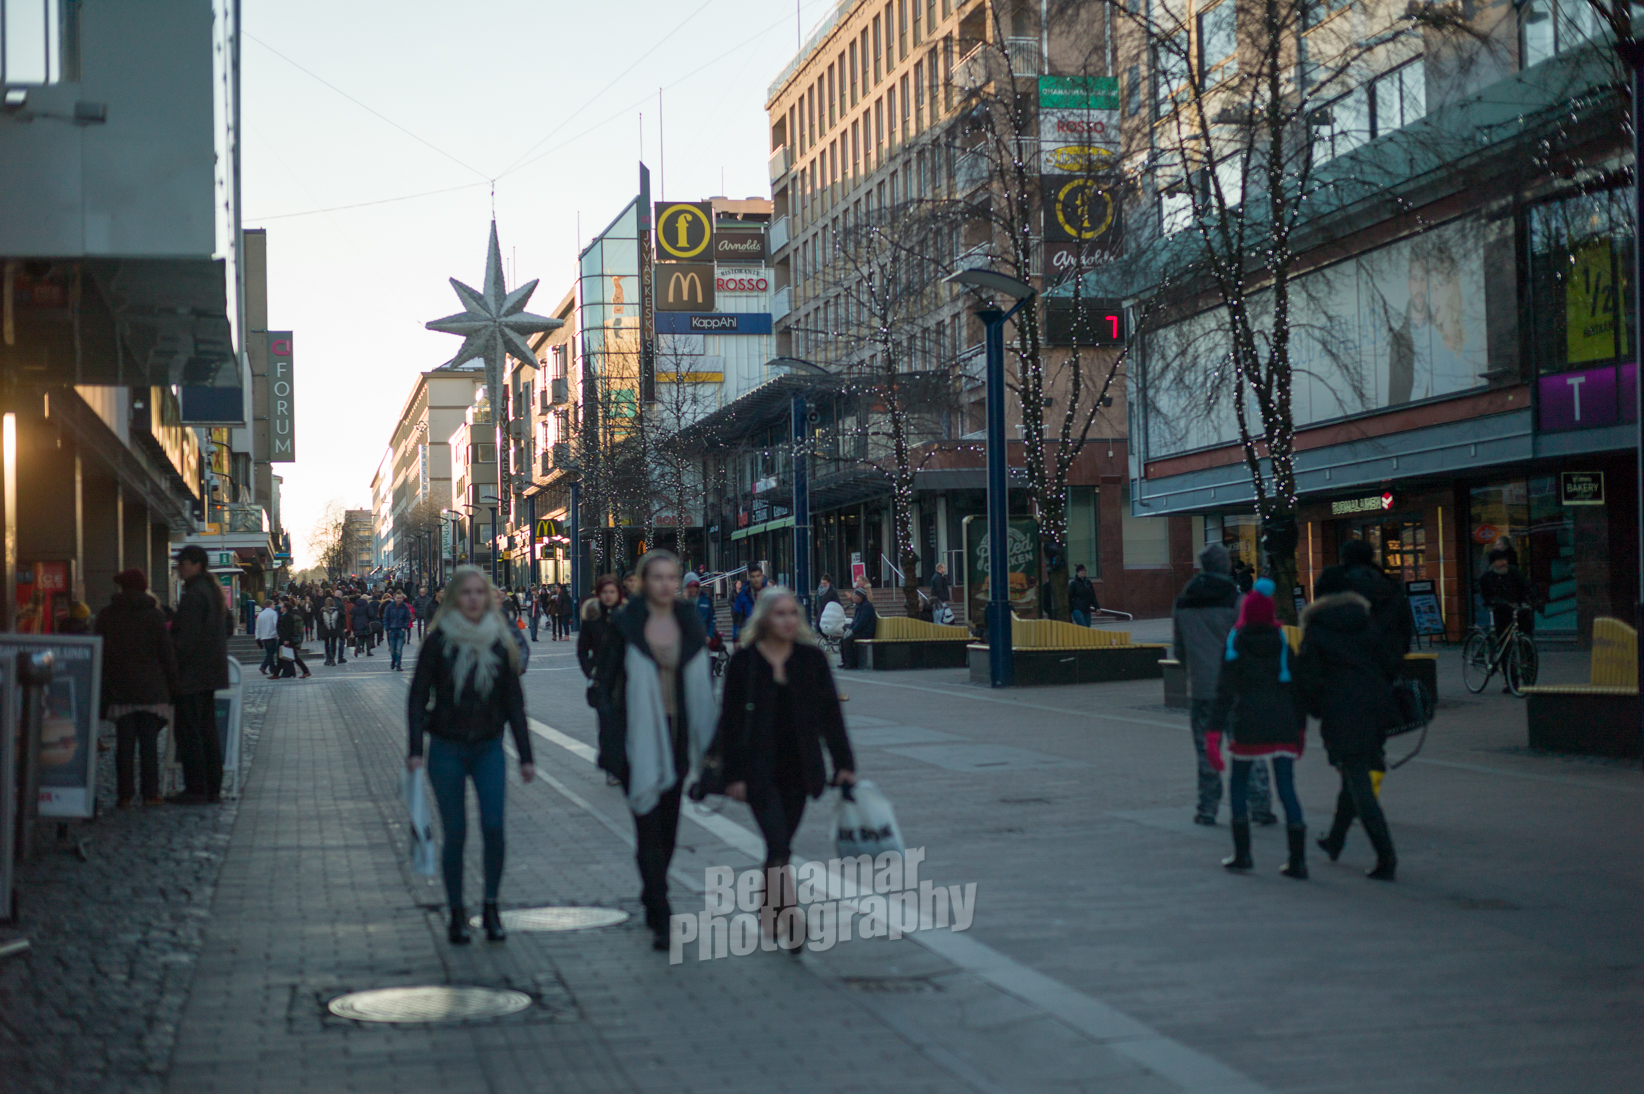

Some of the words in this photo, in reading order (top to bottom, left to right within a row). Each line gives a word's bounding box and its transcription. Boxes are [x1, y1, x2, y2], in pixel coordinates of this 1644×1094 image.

[1057, 120, 1105, 133] ROSSO
[718, 239, 761, 252] Arnolds
[721, 268, 760, 276] RISTORANTE
[643, 231, 653, 352] JYVÄSKESKUS
[716, 278, 768, 292] ROSSO
[692, 316, 737, 330] KappAhl
[1566, 376, 1586, 422] T
[274, 362, 291, 454] FORUM
[500, 399, 510, 512] JYVÄSKESKUS
[1566, 483, 1599, 493] BAKERY
[656, 515, 693, 525] ROSO
[976, 533, 1033, 572] Pled
[983, 552, 1034, 573] CKEN
